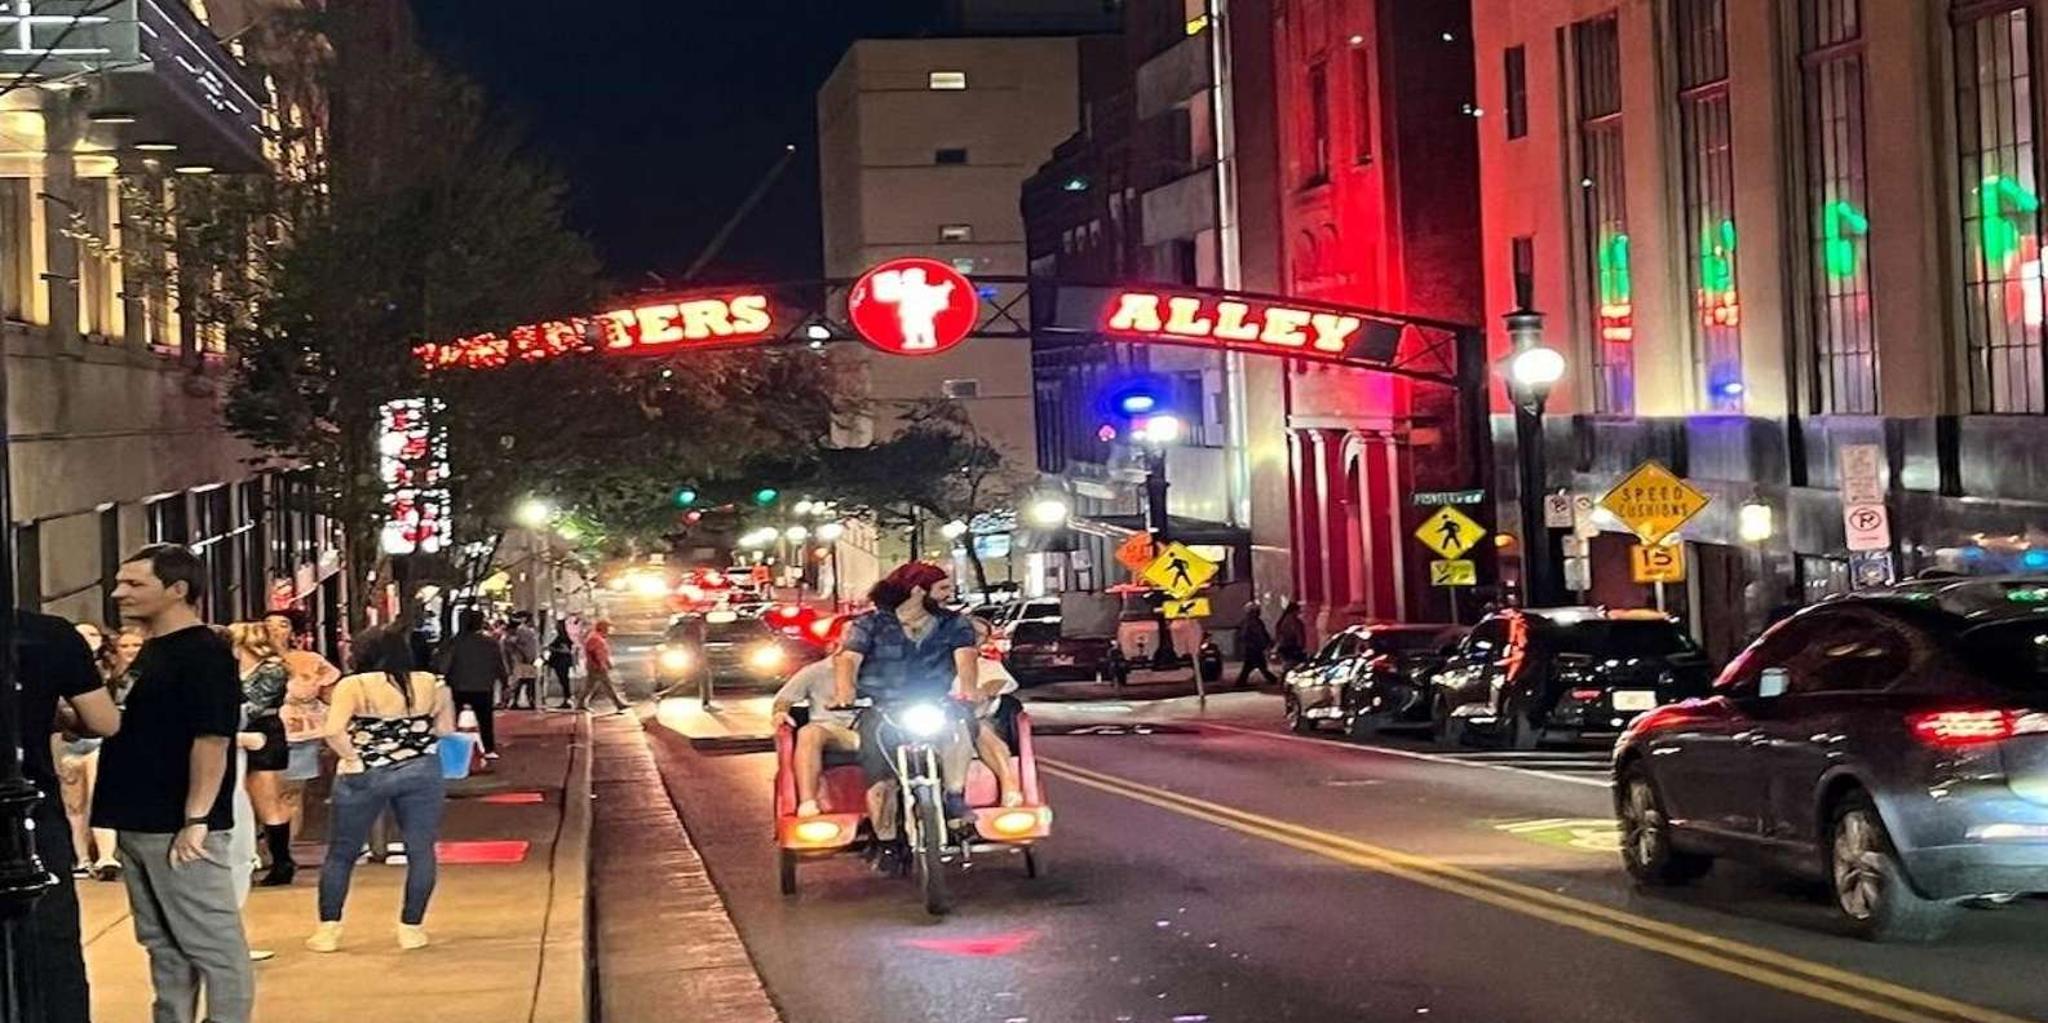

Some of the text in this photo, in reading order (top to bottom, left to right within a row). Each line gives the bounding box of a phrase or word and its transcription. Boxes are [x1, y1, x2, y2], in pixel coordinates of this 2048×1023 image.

[1109, 293, 1360, 352] ALLEY
[1622, 486, 1684, 502] SPEED
[1618, 503, 1688, 518] CUSHIONS
[1643, 548, 1673, 566] 15
